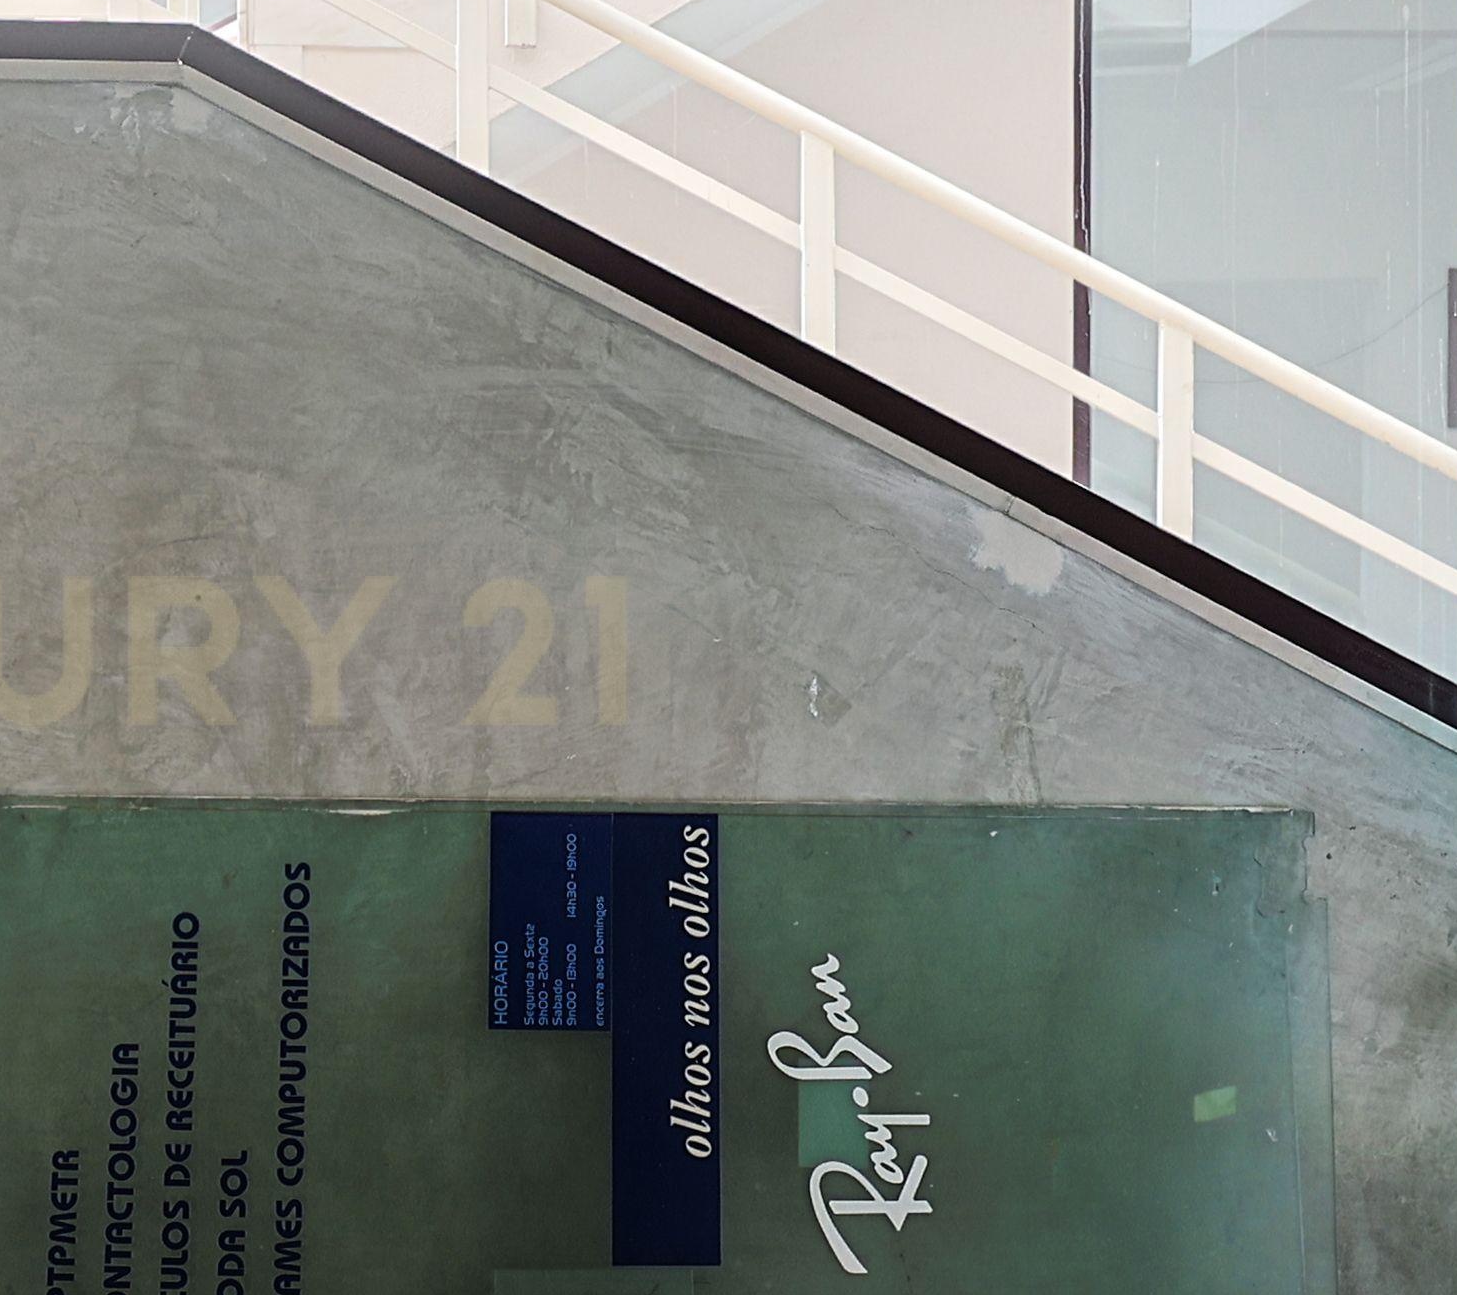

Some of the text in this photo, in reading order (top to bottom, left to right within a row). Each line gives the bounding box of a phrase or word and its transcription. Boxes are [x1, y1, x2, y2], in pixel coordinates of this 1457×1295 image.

[567, 834, 577, 870] 19h00
[567, 882, 577, 917] 14h30
[492, 941, 508, 1024] HORÁRIO
[539, 937, 549, 980] 20h00
[567, 944, 577, 980] 13h00
[594, 896, 607, 1026] encerra aos Domingos
[524, 973, 535, 1025] Segunda
[539, 991, 549, 1025] 9h00
[669, 825, 713, 1158] olhos nos olhos
[163, 912, 200, 1130] RECEITUÁRIO
[277, 862, 310, 1186] COMPUTORIZADOS
[165, 1144, 192, 1186] DE
[219, 1150, 249, 1218] SOL
